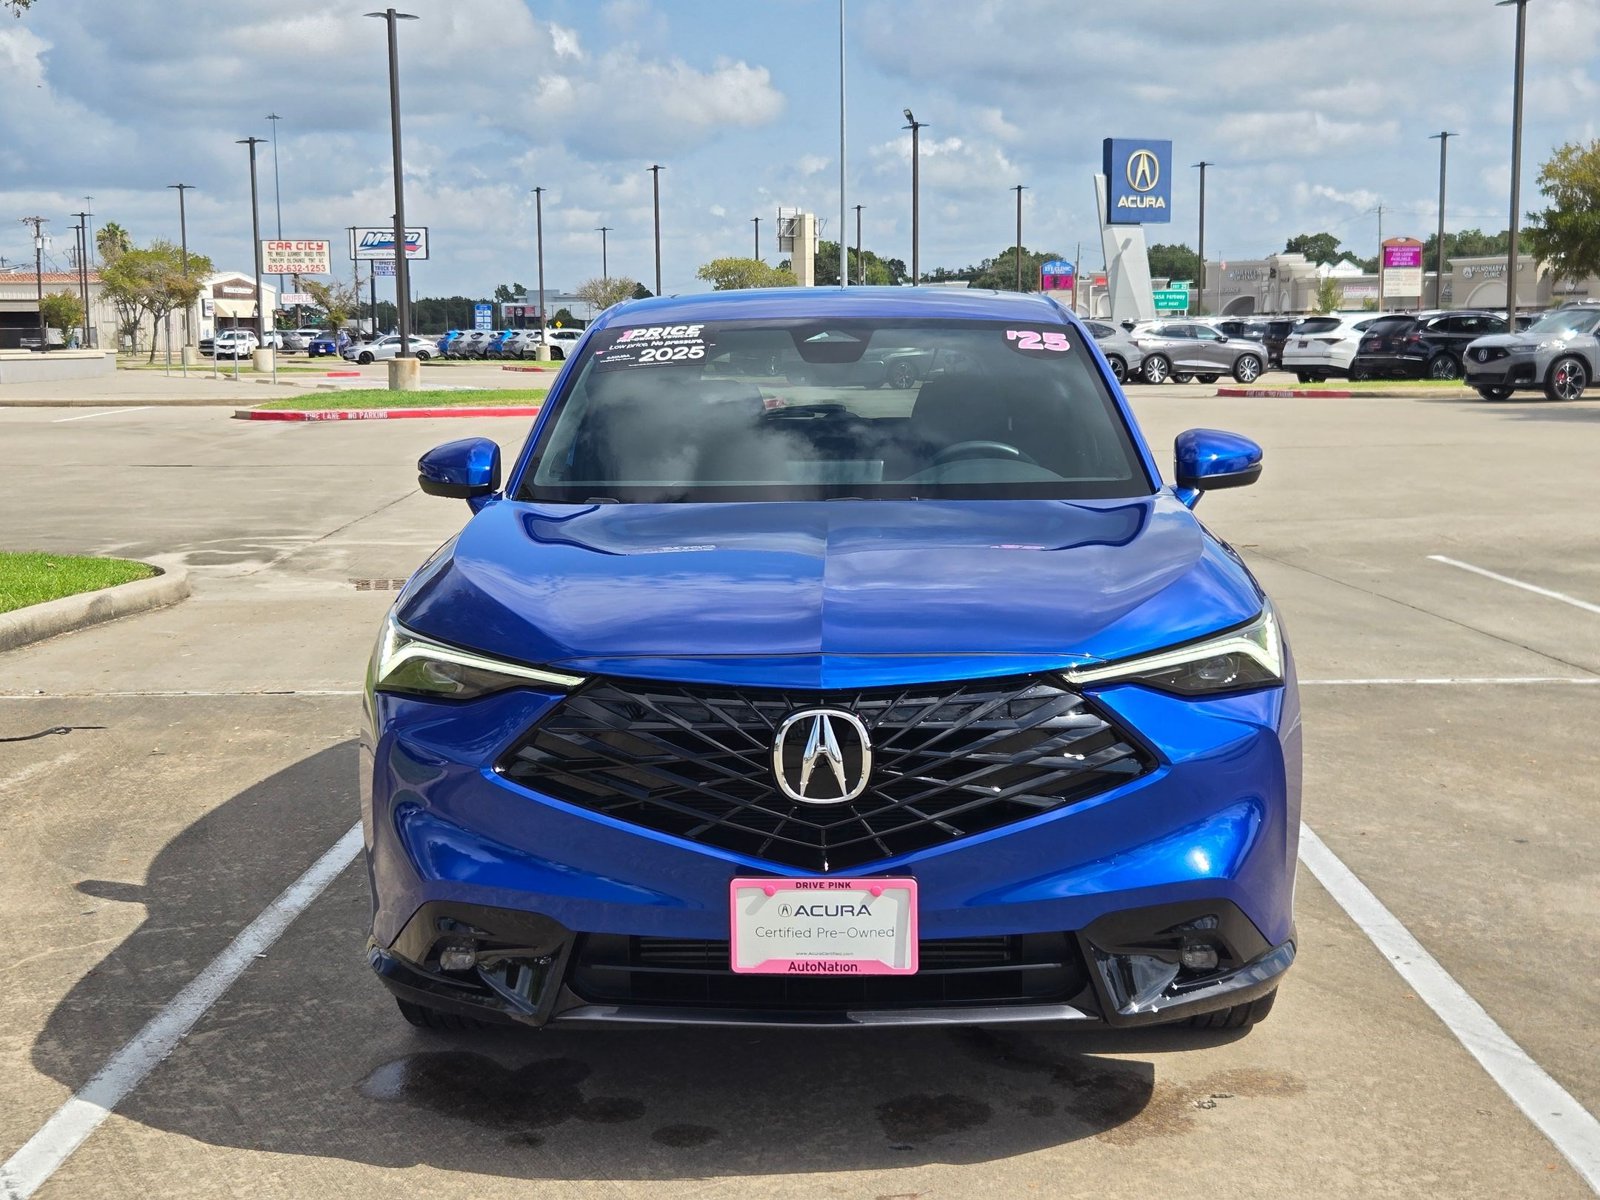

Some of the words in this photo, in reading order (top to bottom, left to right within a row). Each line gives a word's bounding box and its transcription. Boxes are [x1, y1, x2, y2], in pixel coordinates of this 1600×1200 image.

[1118, 195, 1166, 209] ACURA
[360, 232, 420, 247] Mao
[268, 242, 292, 251] CAR
[296, 242, 324, 251] CITY
[267, 264, 326, 272] 832-632-1253
[1006, 330, 1071, 352] '25
[638, 345, 706, 363] 2025
[323, 412, 340, 420] LANE
[348, 411, 357, 419] NO
[360, 411, 388, 419] PARKING
[795, 881, 825, 889] DRIVE
[828, 881, 852, 889] PINK
[794, 904, 872, 917] ACURA
[755, 926, 812, 939] Certified
[817, 926, 895, 939] Pre-Owned
[788, 961, 858, 972] AutoNation
